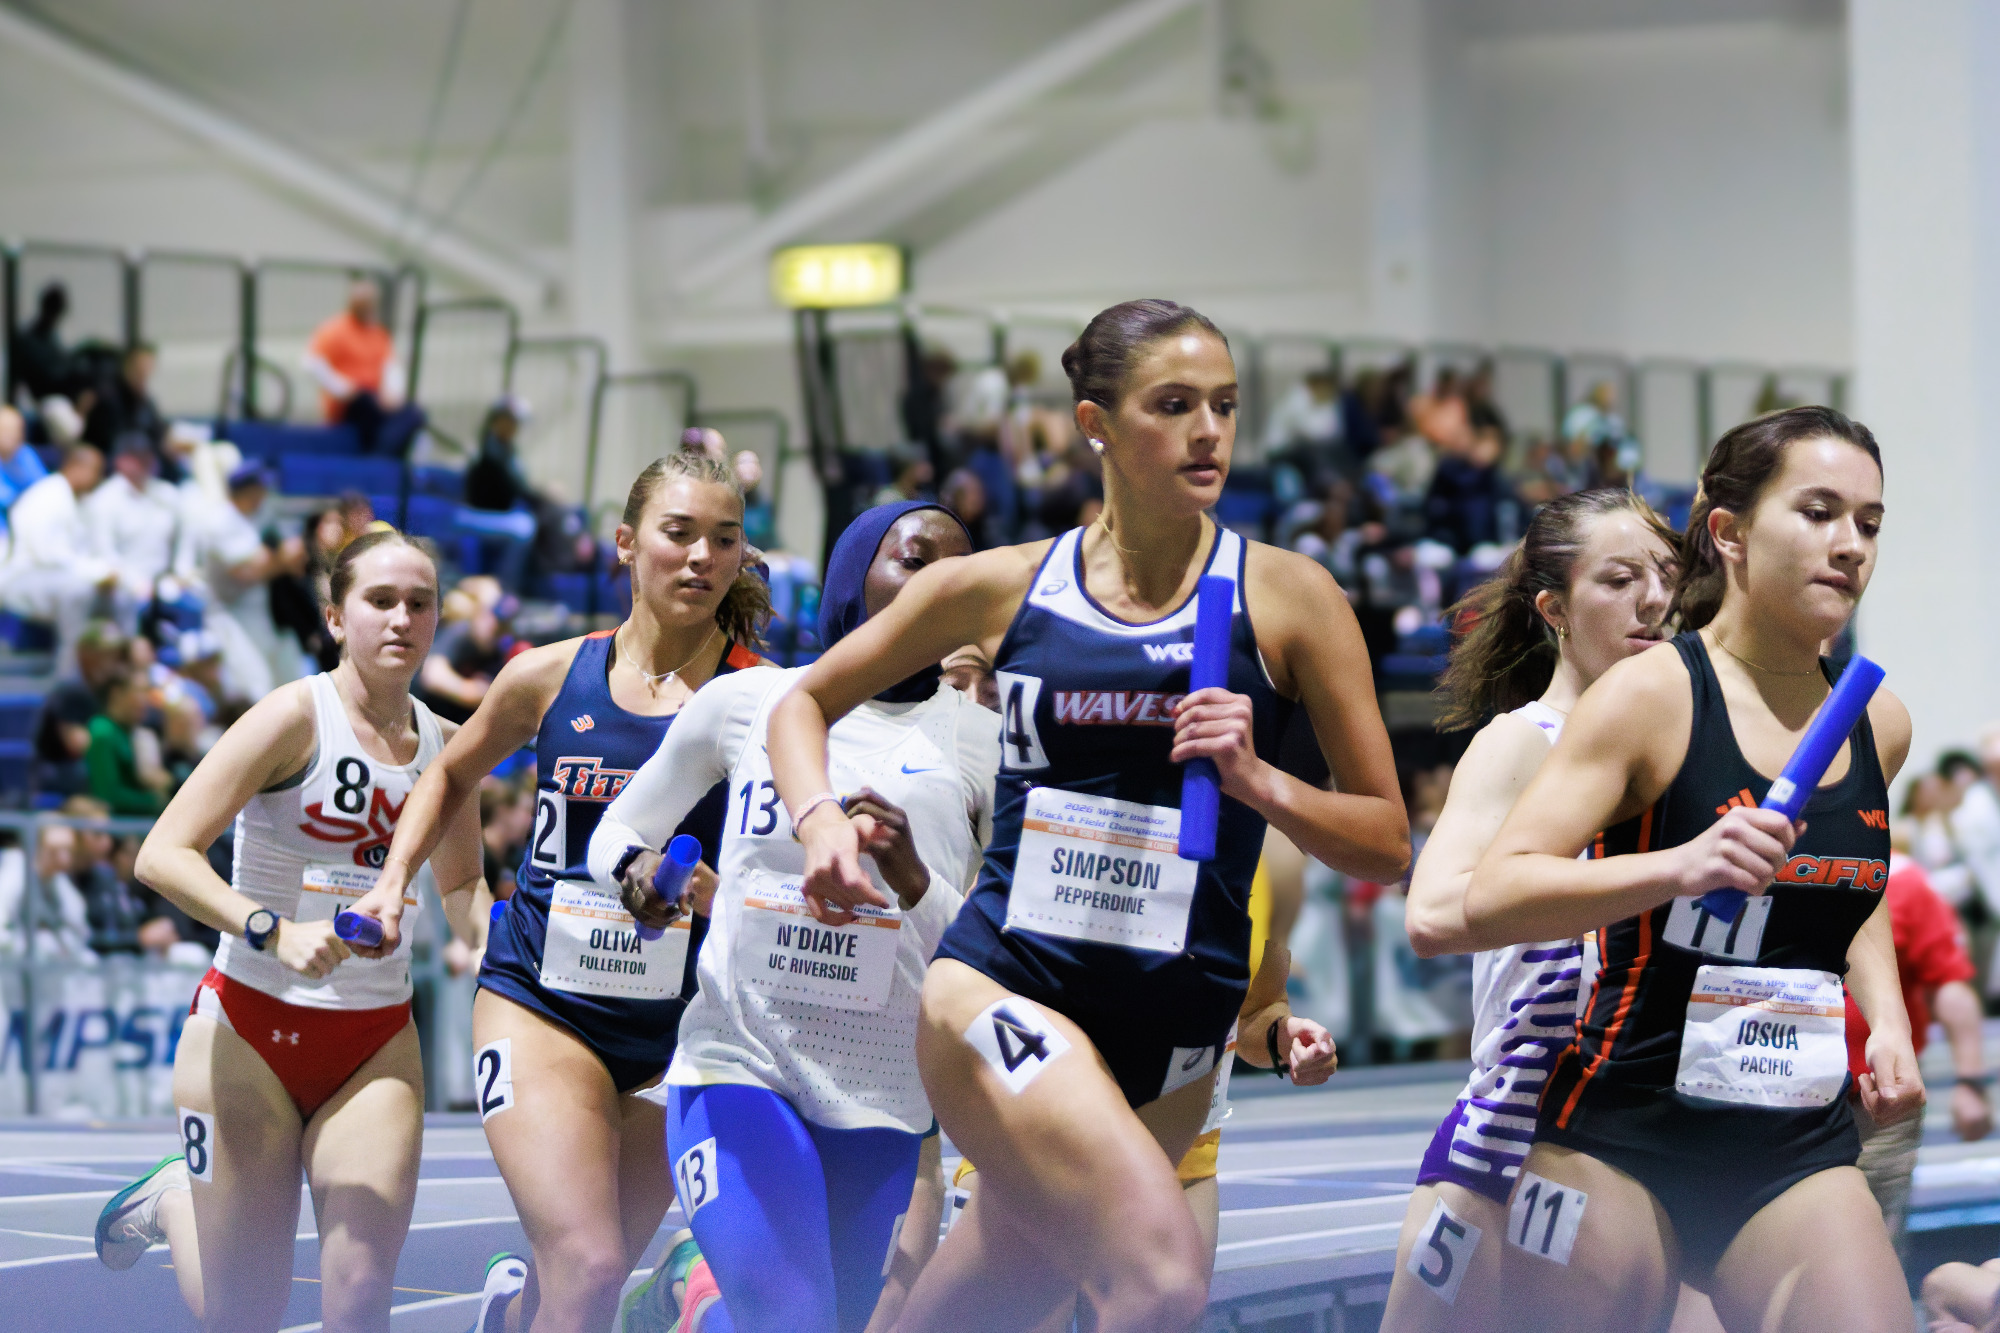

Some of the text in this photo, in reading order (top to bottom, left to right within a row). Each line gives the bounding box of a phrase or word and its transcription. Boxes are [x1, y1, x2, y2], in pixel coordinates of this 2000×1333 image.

[1006, 681, 1032, 763] 4
[333, 756, 371, 814] 8
[552, 756, 638, 802] TIT
[533, 797, 558, 864] 2
[740, 780, 782, 836] 13
[780, 882, 802, 892] 202
[1051, 846, 1161, 890] SIMPSON
[1054, 884, 1146, 916] PEPPERDINE
[1690, 896, 1750, 955] 11
[579, 954, 647, 975] FULLERTON
[590, 928, 642, 954] OLIVA
[769, 952, 859, 982] UC RIVERSIDE
[777, 921, 858, 958] N'DIAYE
[991, 1003, 1051, 1074] 4
[1737, 1018, 1799, 1050] IOSUA
[478, 1048, 505, 1118] 2
[1740, 1055, 1793, 1077] PACIFIC
[184, 1115, 208, 1175] 8
[680, 1148, 707, 1213] 13
[1520, 1181, 1564, 1255] 11
[1418, 1211, 1467, 1288] 5
